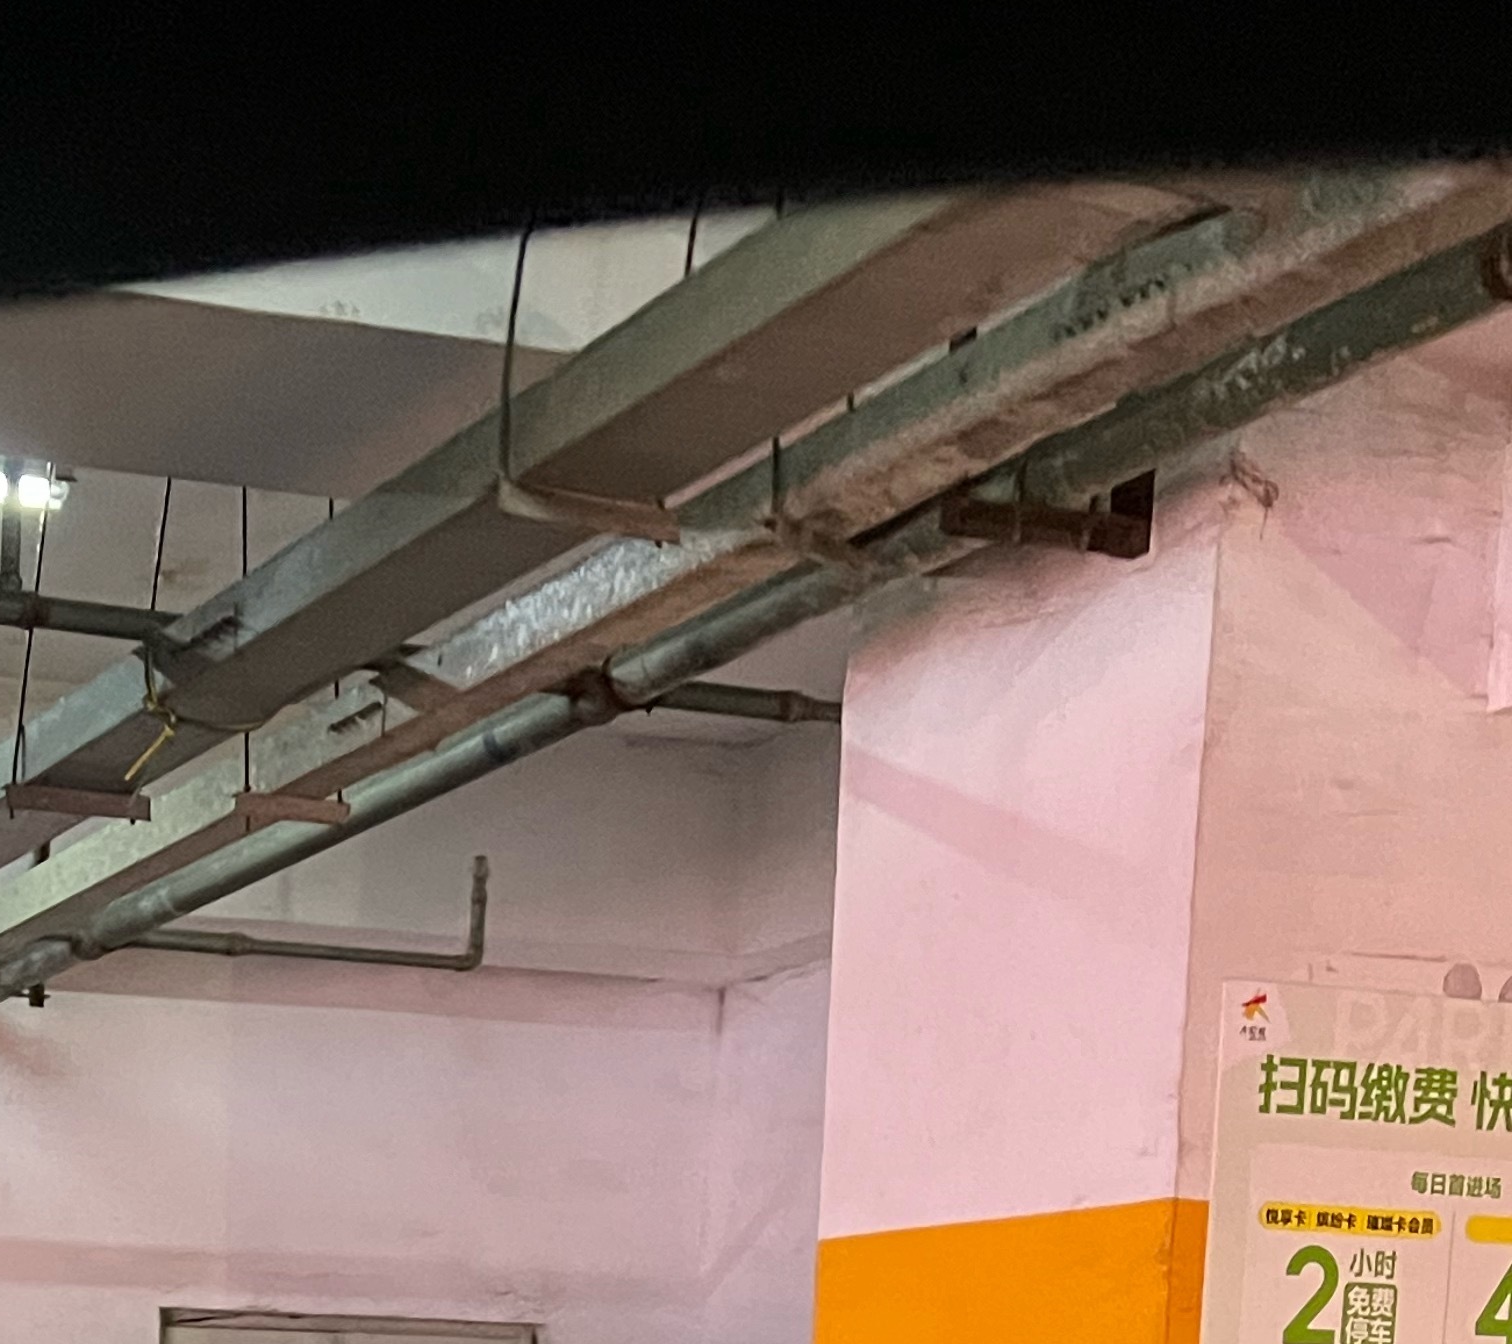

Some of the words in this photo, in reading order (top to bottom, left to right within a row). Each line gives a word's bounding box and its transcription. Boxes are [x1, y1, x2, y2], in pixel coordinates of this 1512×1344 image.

[1259, 1054, 1457, 1127] 扫码缴费
[1471, 1071, 1512, 1132] 快
[1411, 1171, 1501, 1199] 每日首进场
[1349, 1248, 1397, 1279] 小时
[1347, 1286, 1395, 1318] 免费
